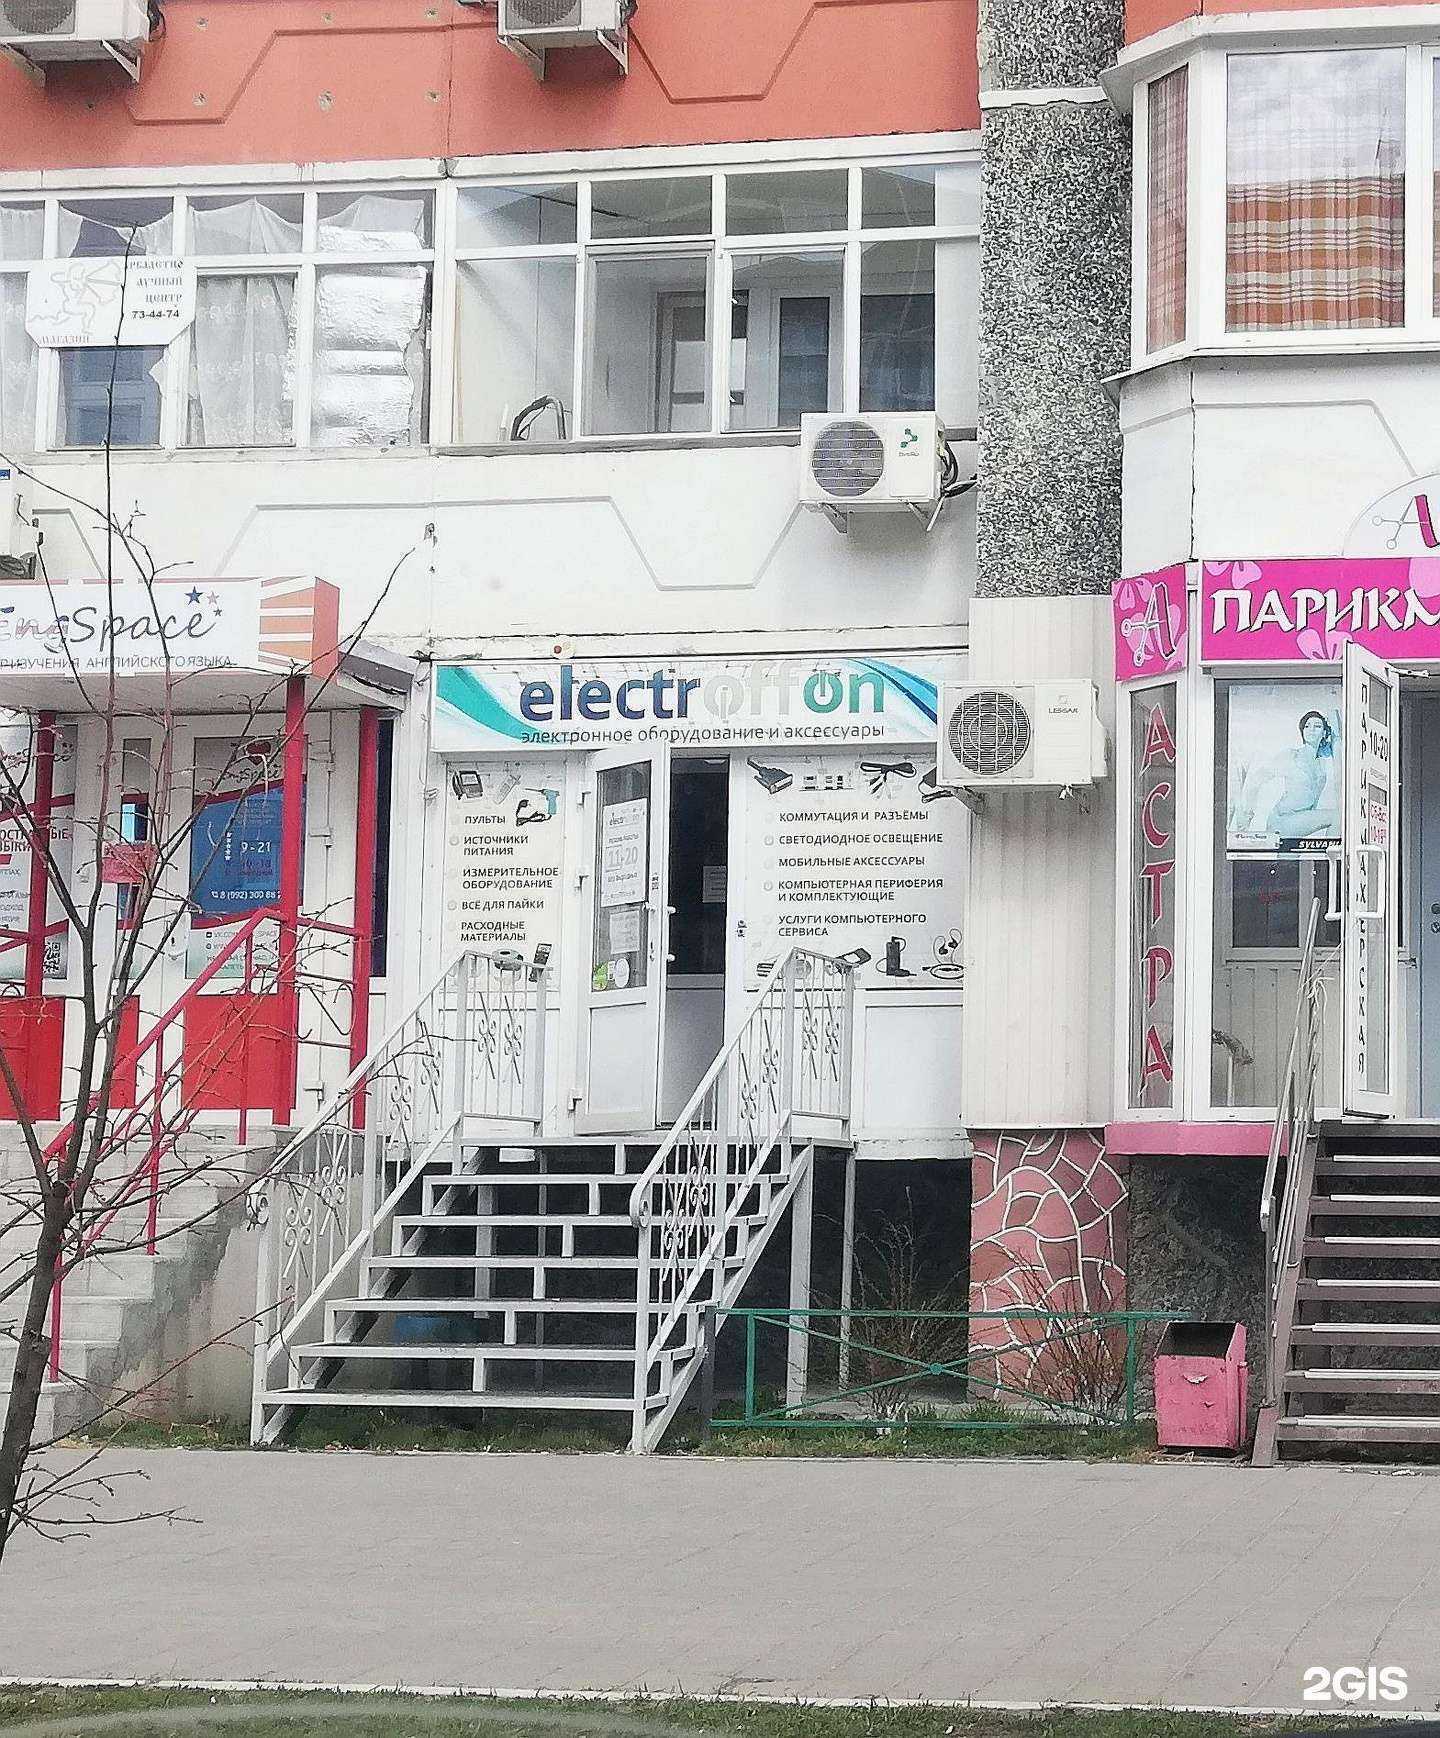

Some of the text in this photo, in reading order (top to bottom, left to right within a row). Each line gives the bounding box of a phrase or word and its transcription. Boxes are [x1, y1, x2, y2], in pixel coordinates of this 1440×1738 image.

[131, 309, 181, 319] 73-44-74
[521, 725, 885, 746] электронное оборудование и аксессуары
[1369, 730, 1389, 762] 10-20
[464, 815, 506, 824] ПУЛЬТЫ
[779, 812, 859, 823] КОММУТАЦИЯ
[861, 812, 869, 820] И
[464, 836, 529, 845] ИСТОЧНИКИ
[779, 834, 943, 846] СВЕТОДИОДНОЕ ОСВЕЩЕНИЕ
[463, 847, 515, 856] ПИТАНИЯ
[778, 856, 925, 867] МОБИЛЬНЫЕ АКСЕССУАРЫ
[463, 867, 559, 877] ИЗМЕРИТЕЛЬНОЕ
[463, 880, 553, 891] ОБОРУДОВАНИЕ
[778, 878, 943, 890] КОМПЬЮТЕРНАЯ ПЕРИФЕРИЯ
[778, 891, 895, 903] И КОМПЛЕКТУЮЩИЕ
[1139, 702, 1176, 1098] АСТРА
[482, 901, 505, 911] ДЛЯ
[507, 899, 544, 910] ПАЙКИ
[778, 914, 927, 925] УСЛУГИ КОМПЬЮТЕРНОГО
[461, 921, 525, 931] РАСХОДНЫЕ
[460, 932, 526, 942] МАТЕРИАЛЫ
[778, 927, 828, 937] СЕРВИСА
